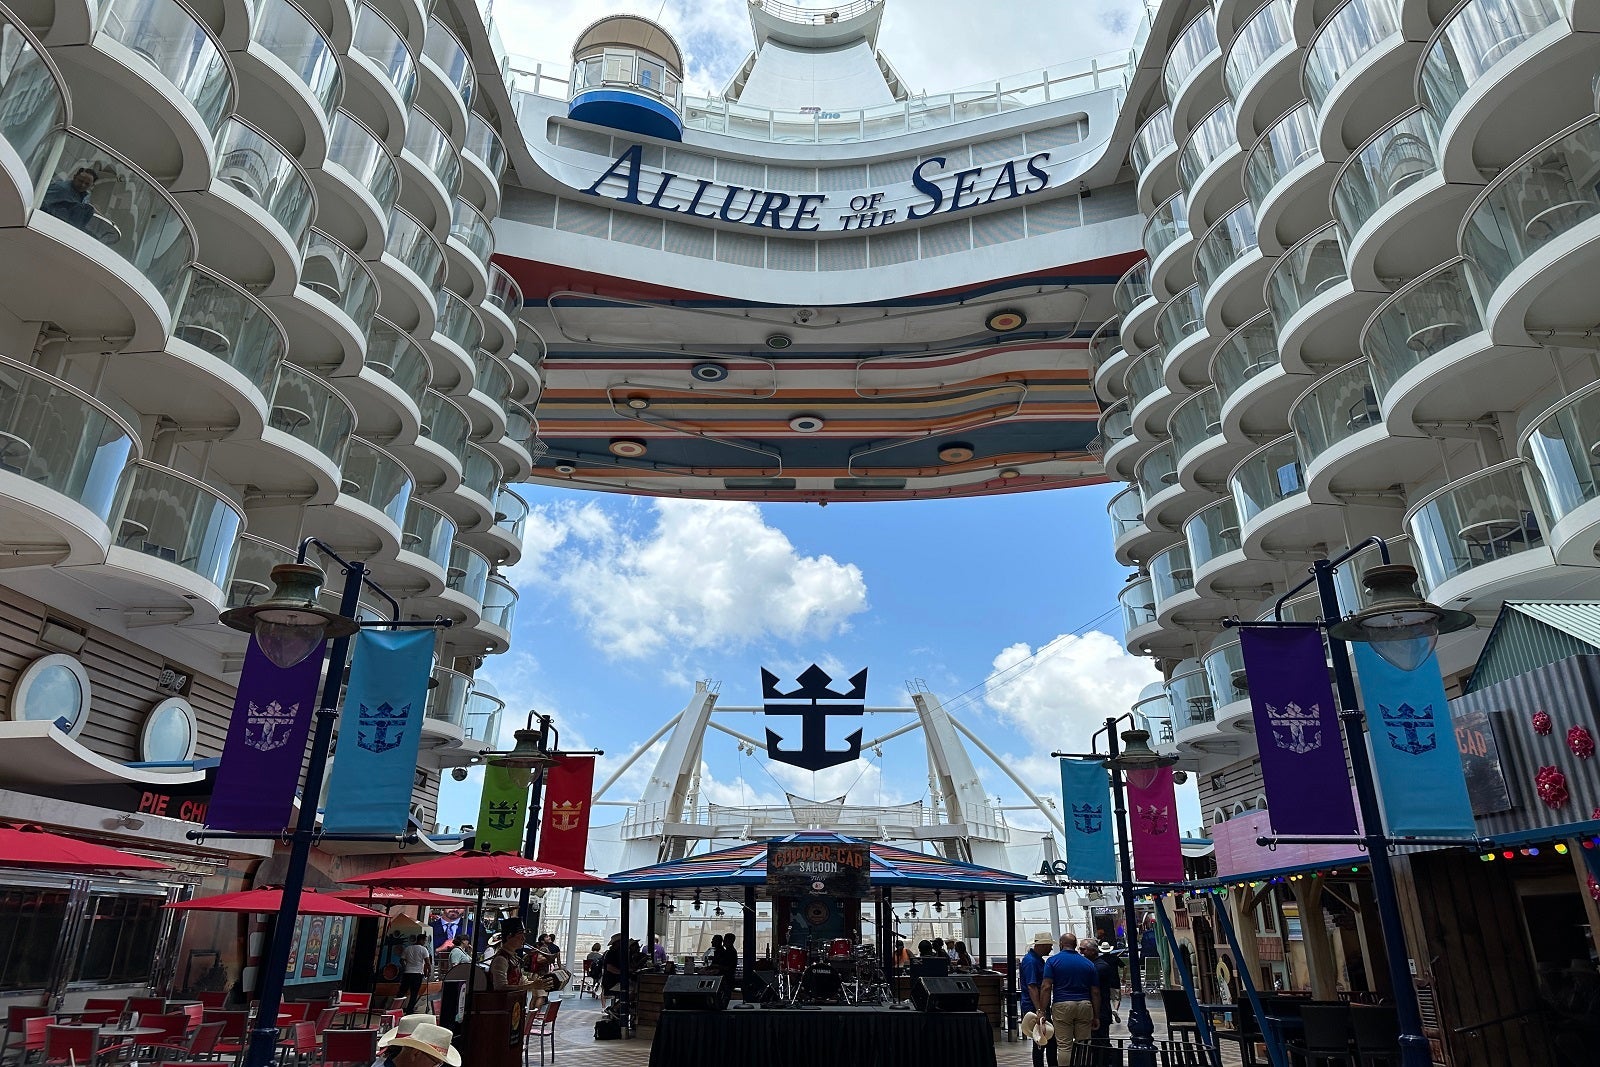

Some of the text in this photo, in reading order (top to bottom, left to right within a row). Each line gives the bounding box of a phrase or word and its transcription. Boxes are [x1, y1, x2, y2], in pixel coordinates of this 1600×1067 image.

[580, 145, 1050, 232] ALLURE OF THE SEAS
[1455, 725, 1487, 757] CAP
[139, 791, 170, 816] PIE
[774, 845, 863, 869] COPPER CAP
[799, 861, 837, 872] SALOON
